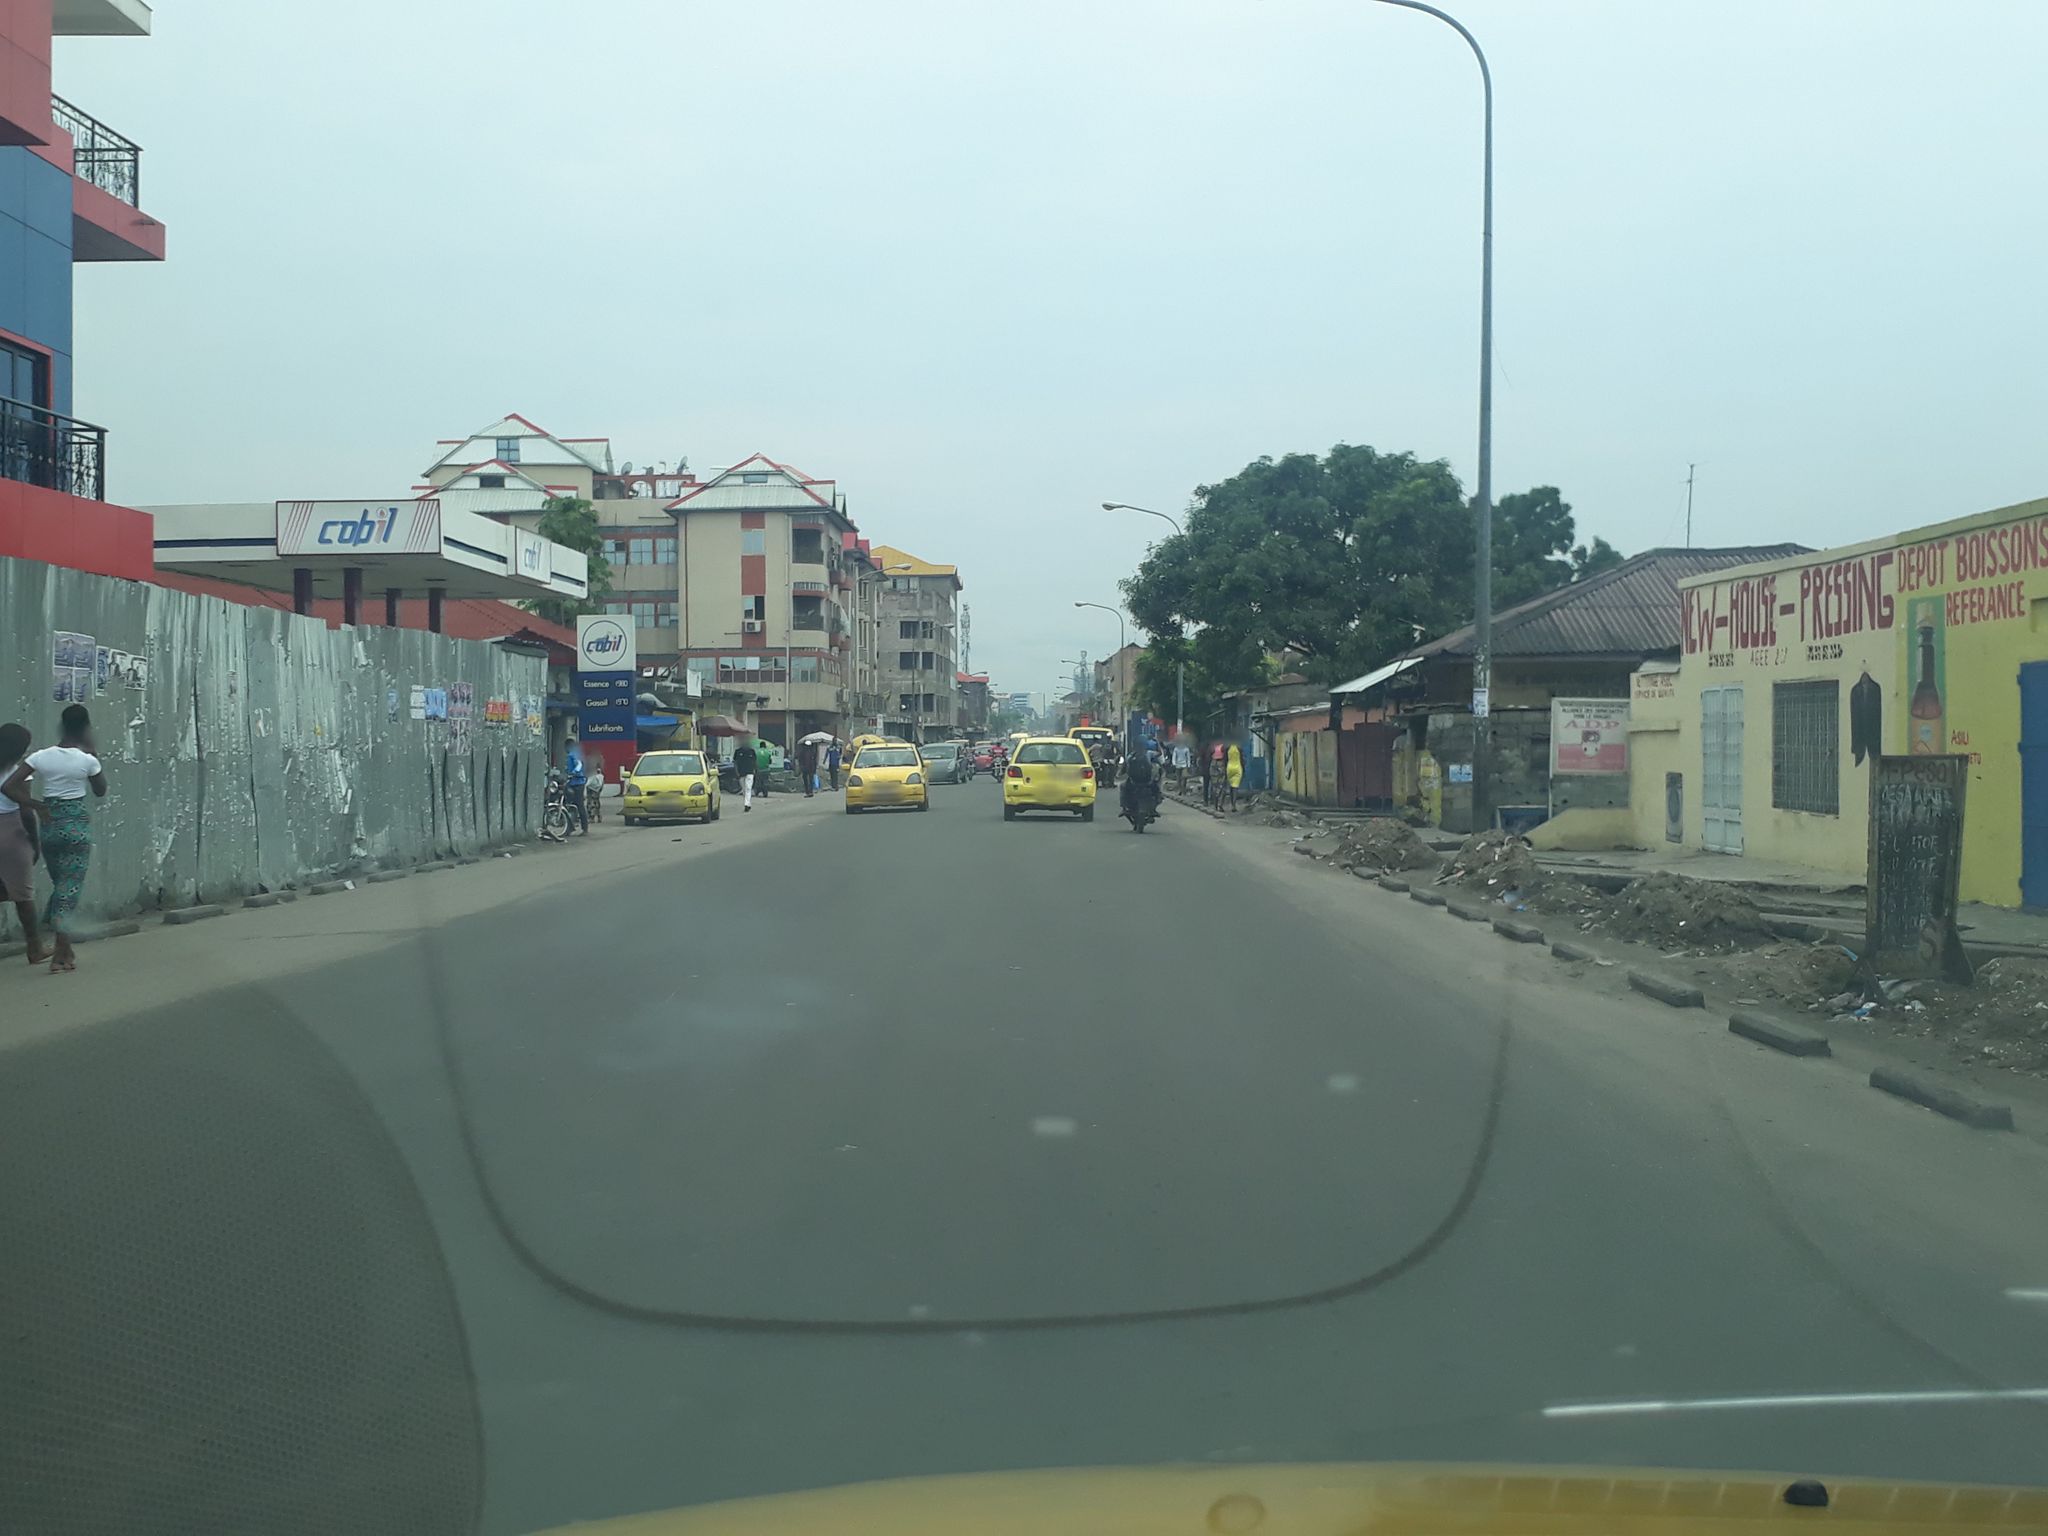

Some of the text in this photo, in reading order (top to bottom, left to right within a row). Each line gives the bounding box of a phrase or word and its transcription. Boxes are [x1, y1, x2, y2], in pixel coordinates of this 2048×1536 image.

[317, 507, 398, 547] cobil
[1897, 517, 2048, 594] DEPOT BOISSONS
[1946, 580, 2026, 627] REFERANCE
[583, 680, 610, 688] Essence
[585, 699, 608, 707] Gasoil
[588, 724, 624, 733] Lubrifiants
